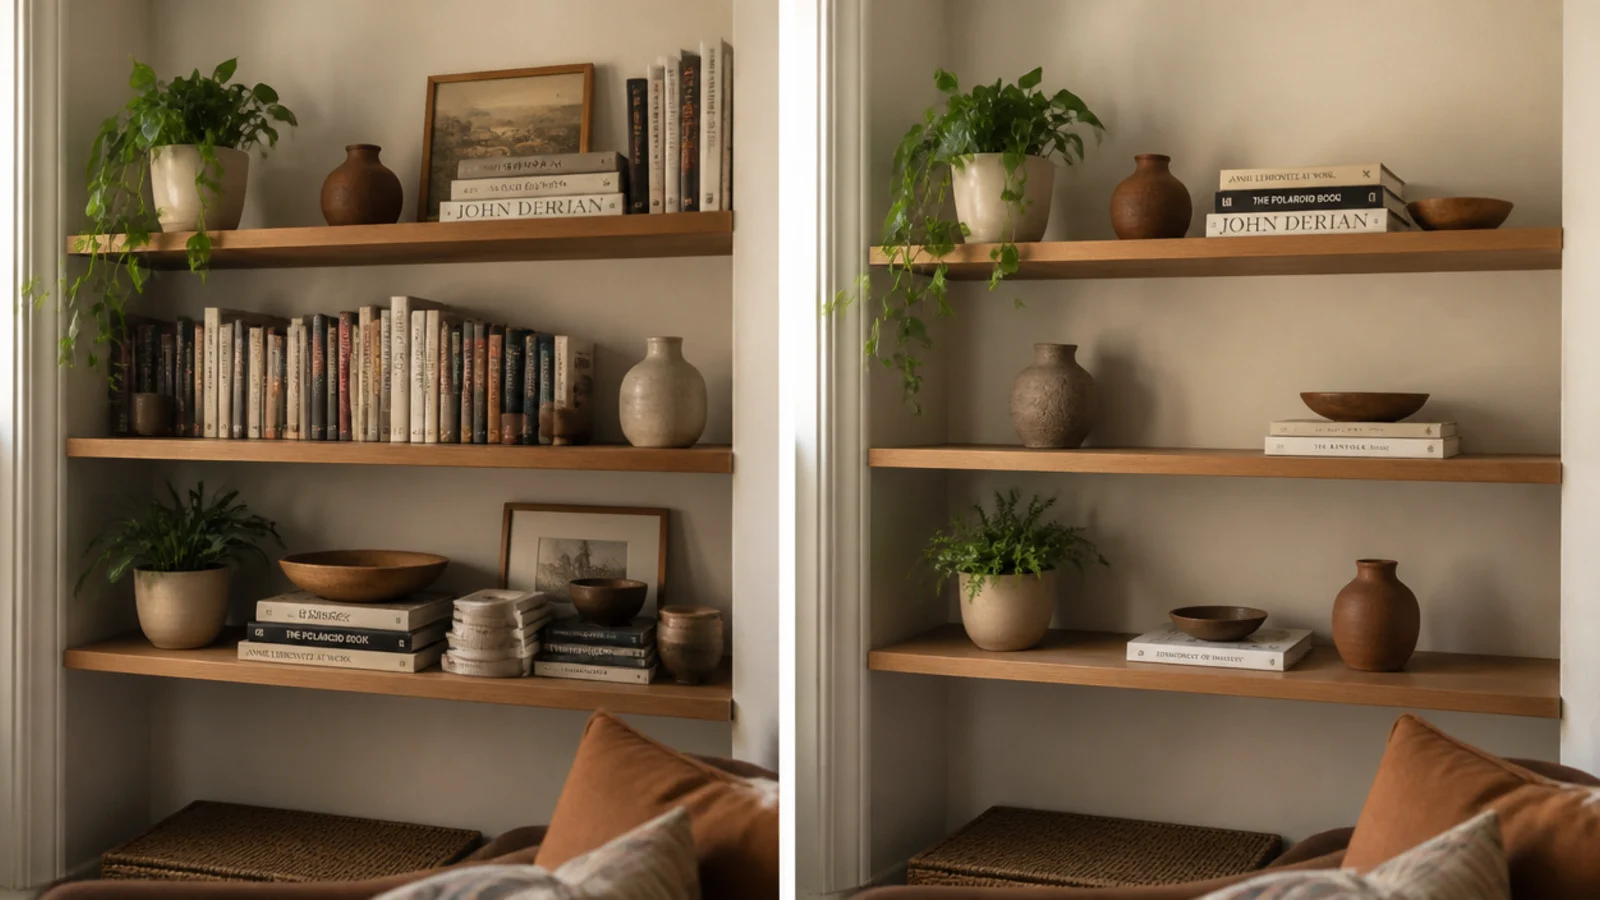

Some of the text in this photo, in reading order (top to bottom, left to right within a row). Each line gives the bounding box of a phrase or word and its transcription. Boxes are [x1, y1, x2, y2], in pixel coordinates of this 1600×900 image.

[457, 201, 511, 220] JOHN
[1252, 196, 1270, 206] THE
[1219, 213, 1369, 235] JOHN DERIAN
